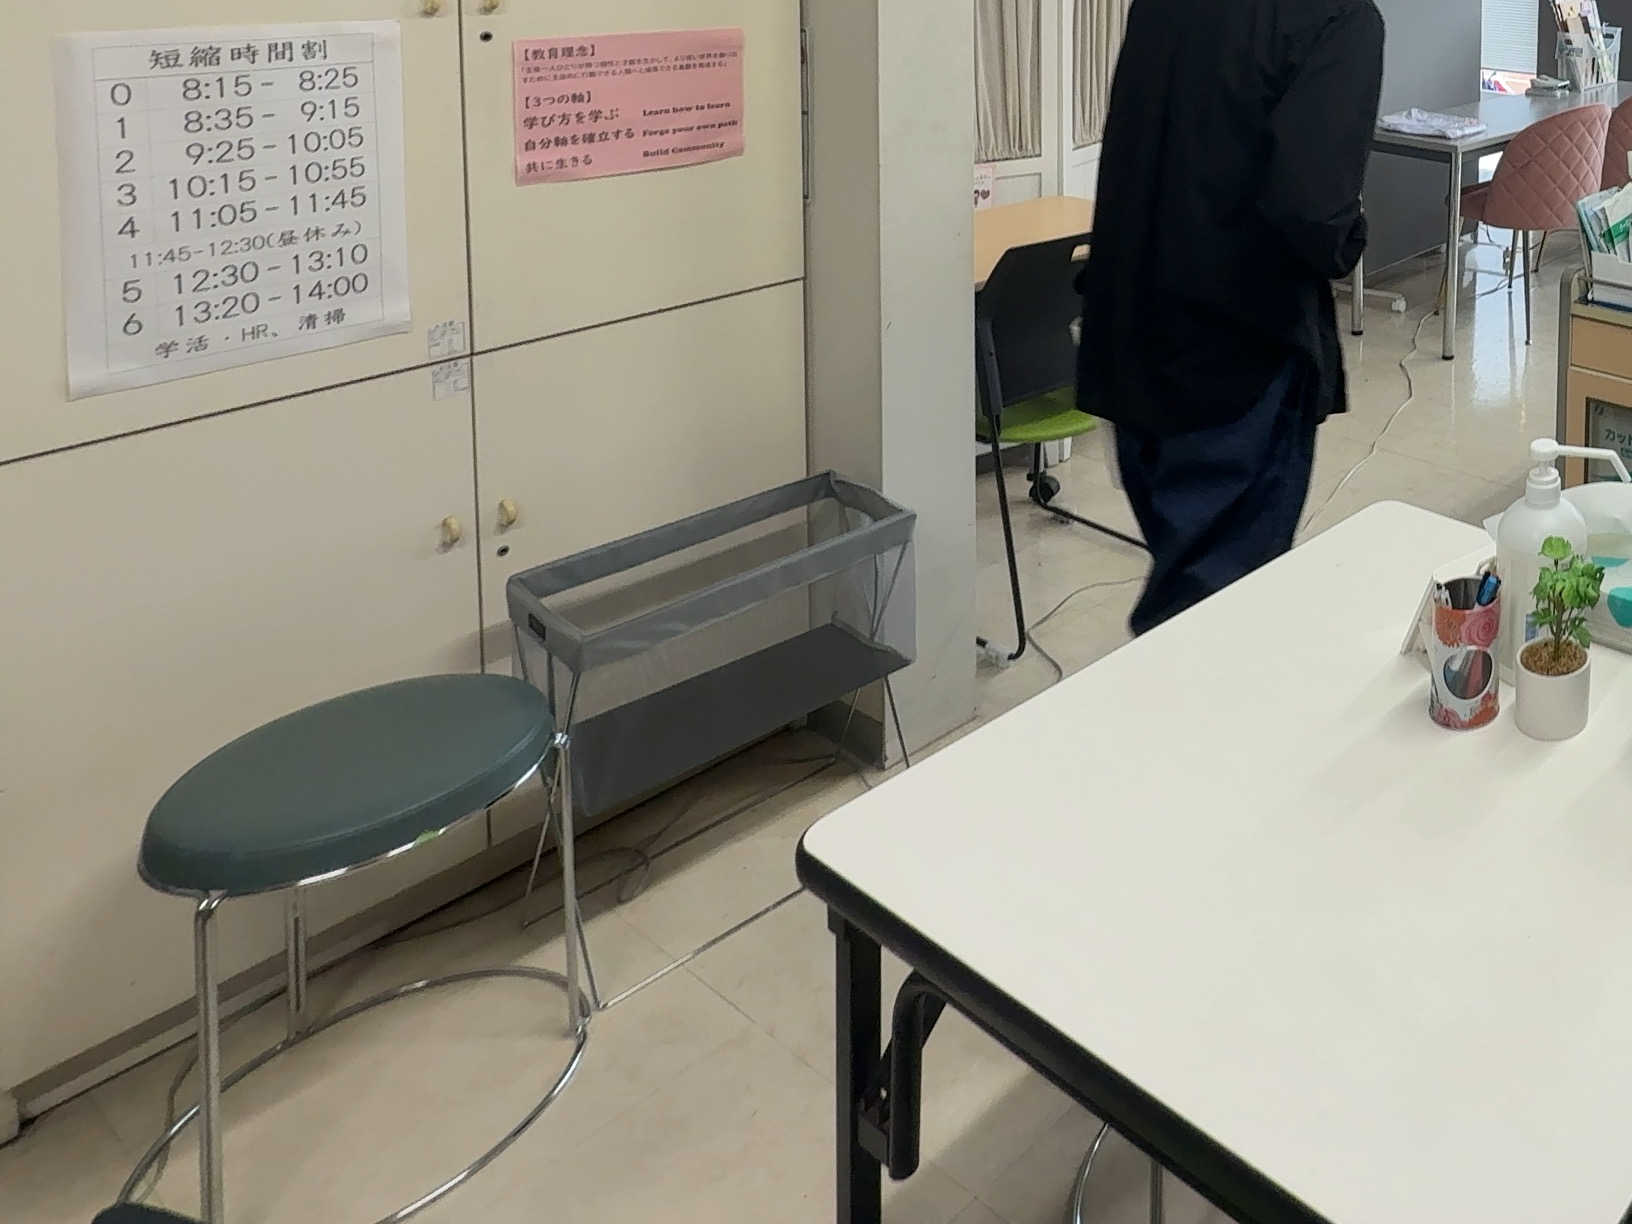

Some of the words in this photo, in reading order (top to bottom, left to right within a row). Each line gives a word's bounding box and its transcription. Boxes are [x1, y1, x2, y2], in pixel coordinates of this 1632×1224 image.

[148, 39, 328, 70] 短縮時間割
[110, 82, 132, 106] 0
[523, 108, 620, 130] 学び方を学ぶ
[642, 108, 670, 117] Learn
[672, 106, 693, 114] how
[707, 102, 731, 110] learn
[116, 116, 127, 139] 1
[642, 129, 670, 137] Forge
[672, 126, 694, 134] your
[524, 128, 635, 151] 自分軸を確立する
[642, 148, 670, 157] Build
[671, 141, 725, 154] Community
[115, 150, 136, 174] 2
[525, 154, 593, 173] 共に生きる
[116, 184, 137, 208] 3
[118, 216, 140, 240] 4
[122, 279, 142, 303] 5
[123, 313, 143, 336] 6
